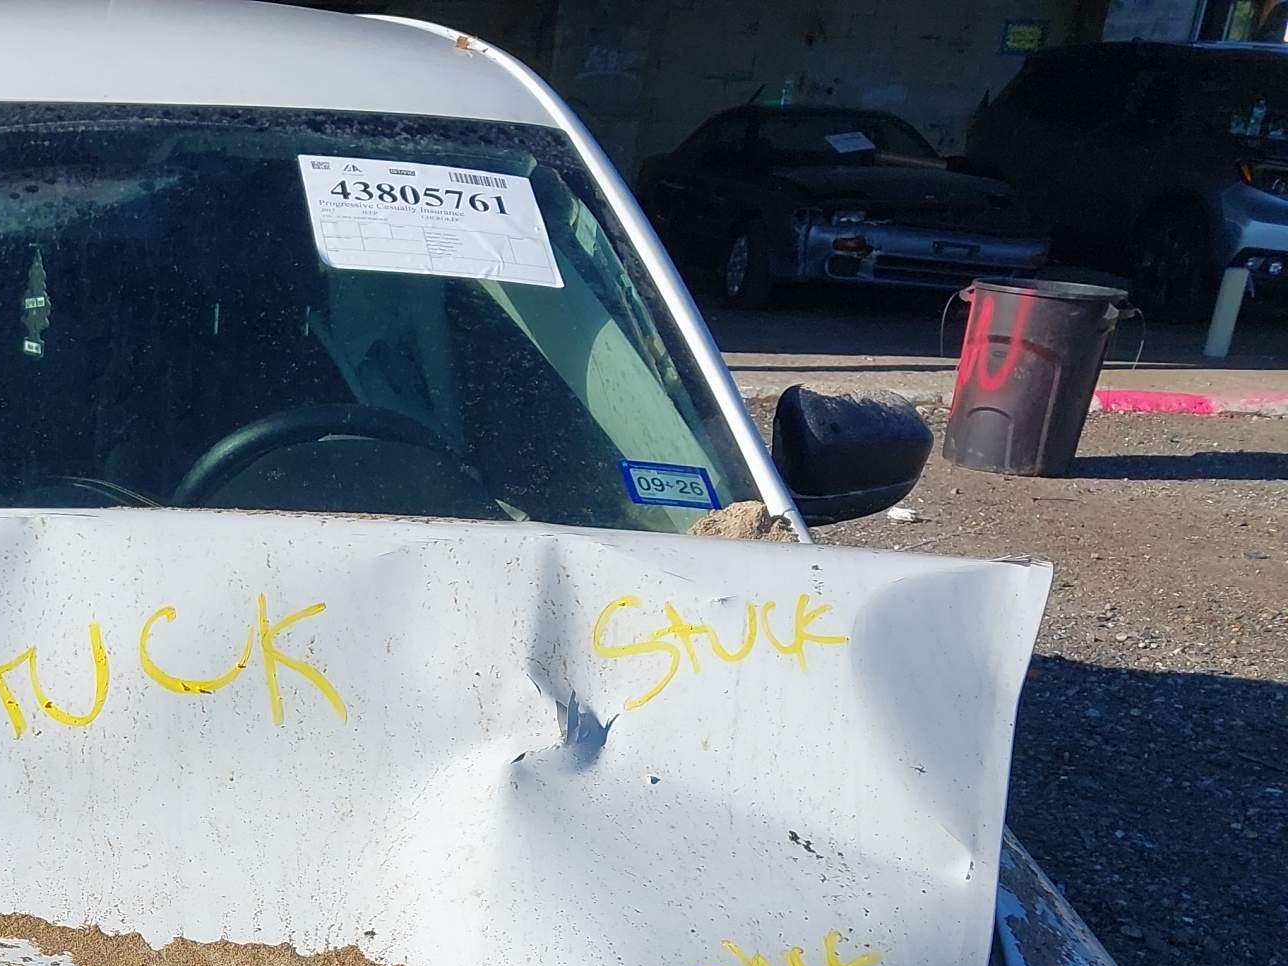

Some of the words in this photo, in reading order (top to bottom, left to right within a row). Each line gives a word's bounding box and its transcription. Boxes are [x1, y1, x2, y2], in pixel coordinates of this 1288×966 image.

[318, 199, 374, 209] Progressive
[376, 203, 417, 213] Casualty
[420, 206, 465, 217] Insurance
[330, 179, 511, 215] 43805761
